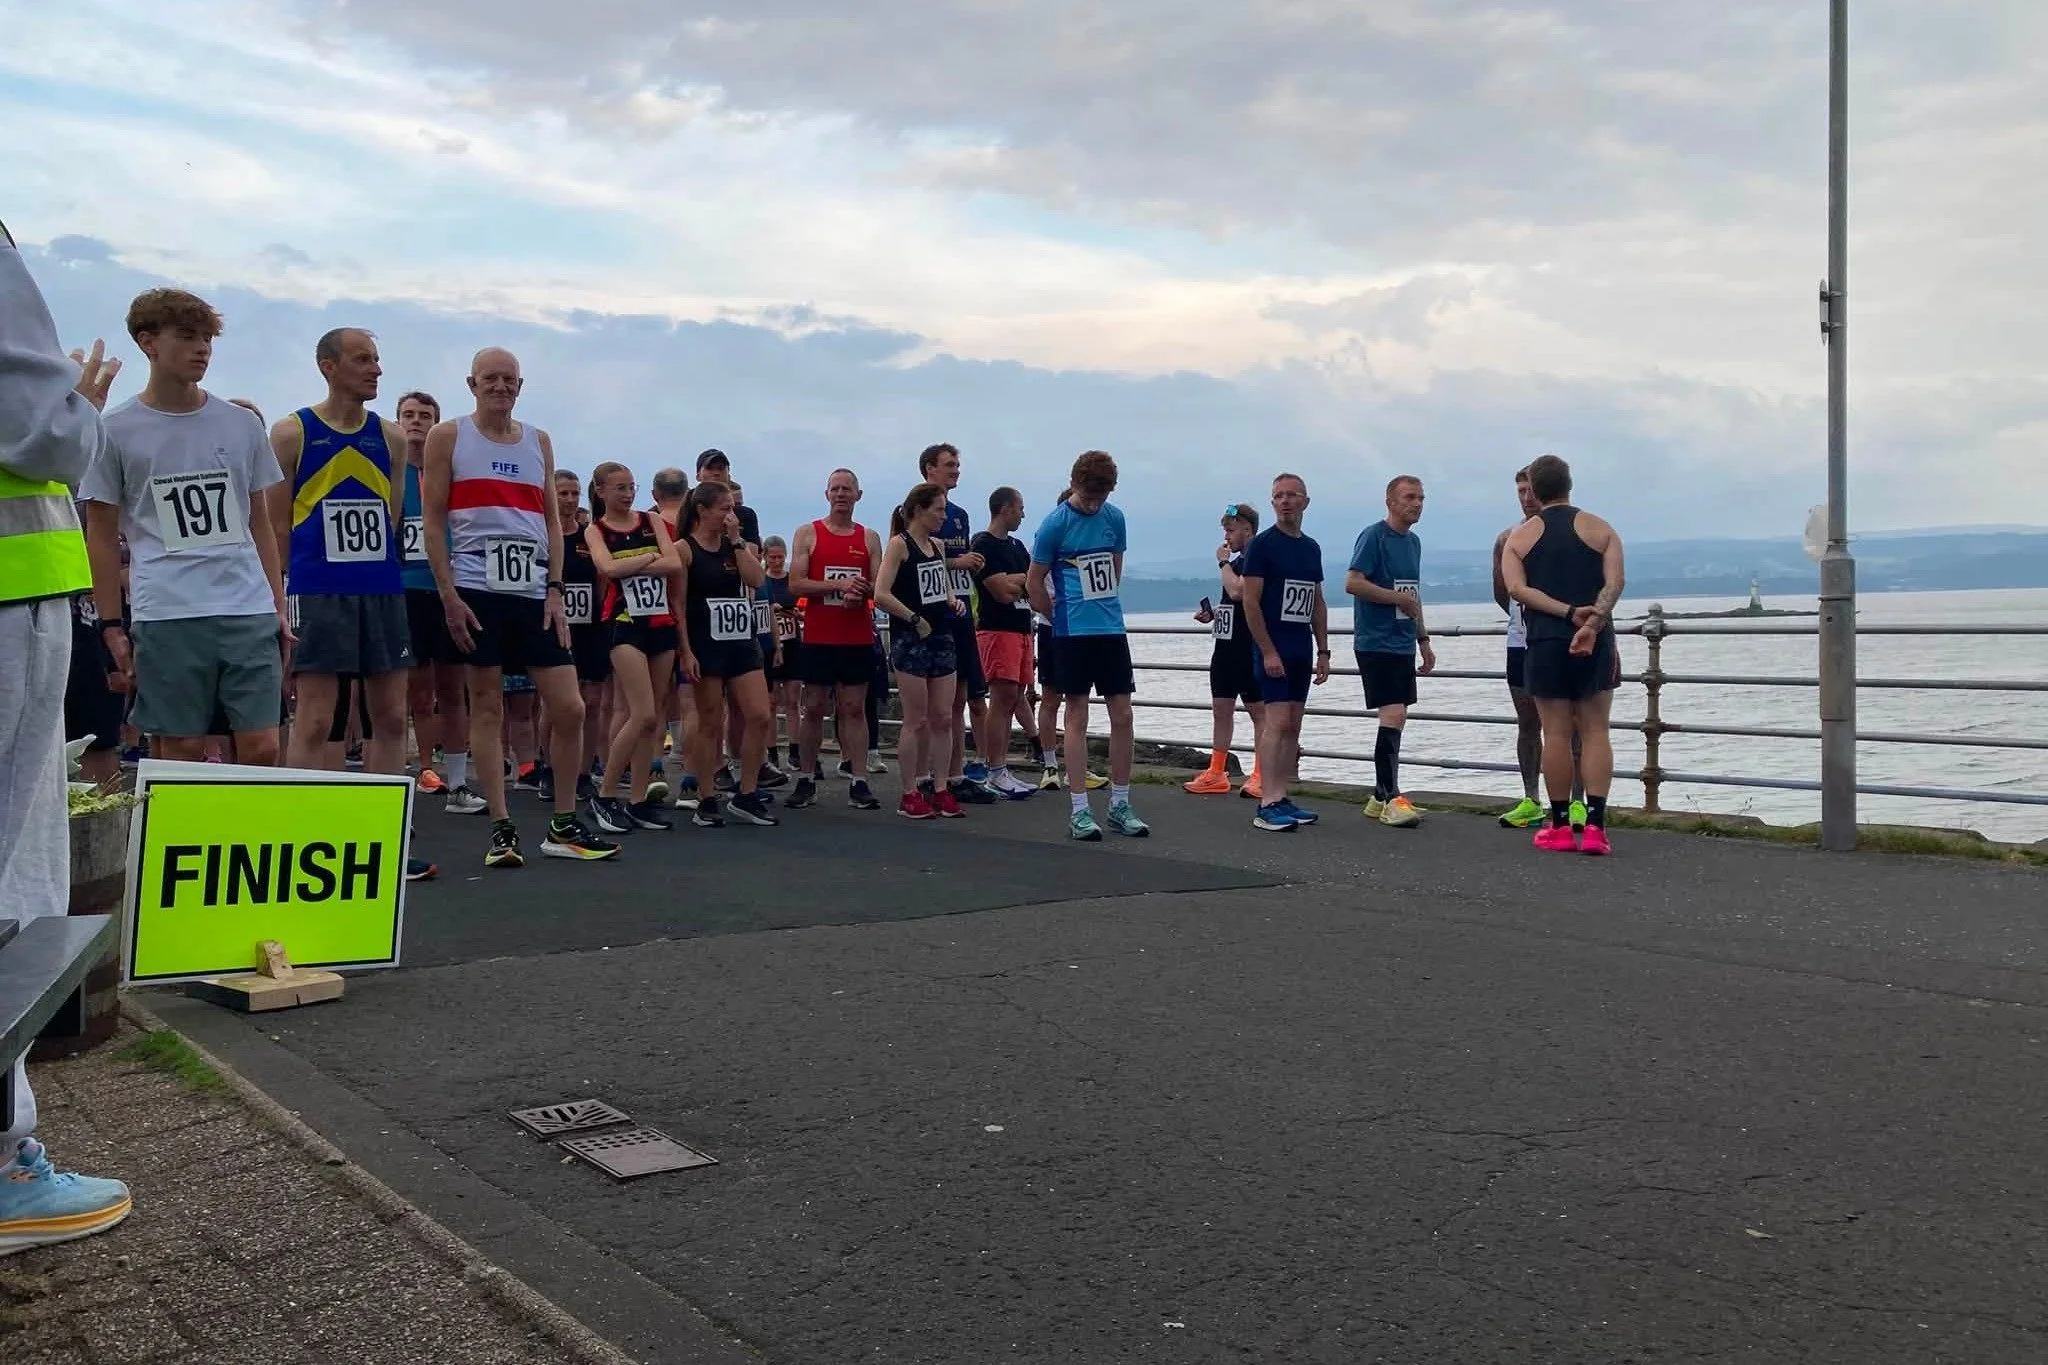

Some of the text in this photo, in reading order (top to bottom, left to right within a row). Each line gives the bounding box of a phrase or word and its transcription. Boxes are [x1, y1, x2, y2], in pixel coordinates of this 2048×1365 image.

[492, 462, 519, 474] FIFE
[163, 482, 229, 538] 197
[329, 509, 382, 552] 198
[491, 544, 535, 583] 167
[1083, 560, 1113, 593] 157
[627, 577, 665, 609] 152
[1284, 587, 1314, 617] 220
[714, 603, 748, 634] 196
[160, 842, 383, 908] FINISH
